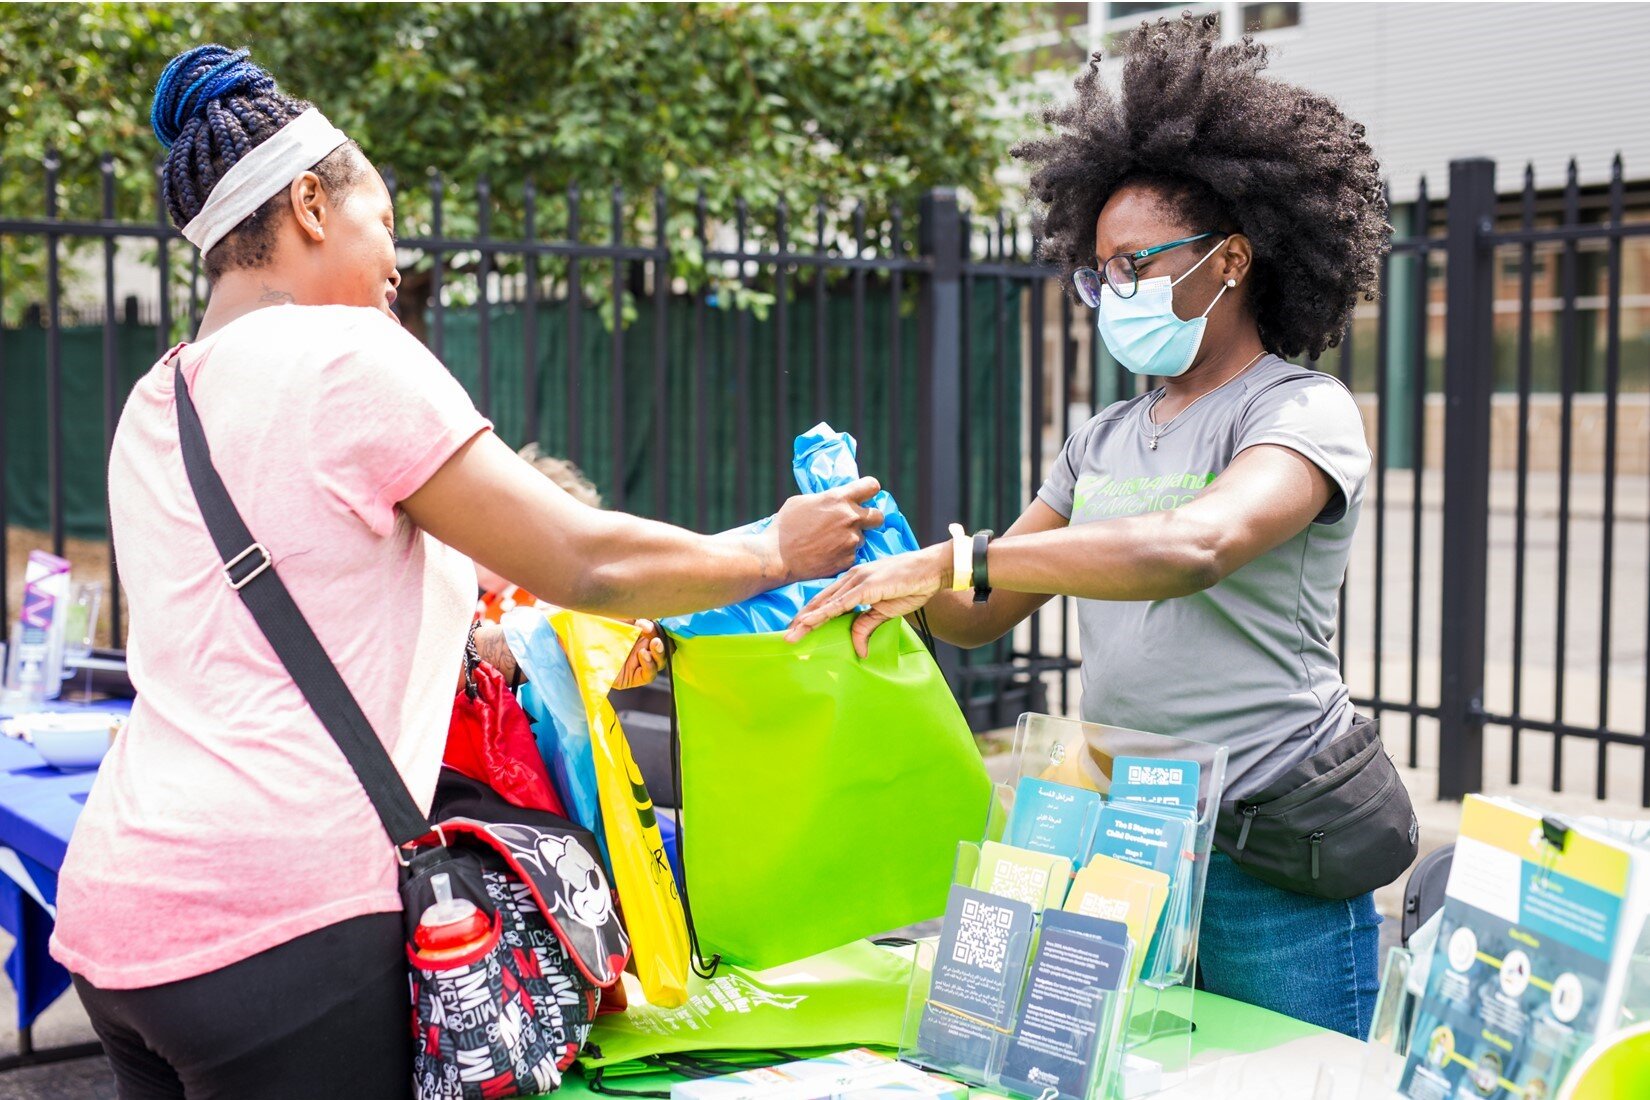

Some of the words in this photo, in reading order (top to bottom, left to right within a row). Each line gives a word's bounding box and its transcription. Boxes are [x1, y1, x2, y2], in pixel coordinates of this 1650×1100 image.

[1115, 820, 1128, 830] The
[1132, 824, 1155, 835] Stages
[1106, 829, 1125, 839] Child
[1124, 833, 1169, 848] Development
[437, 979, 461, 1012] KEY
[462, 998, 499, 1030] MIC
[435, 1077, 463, 1096] KEY
